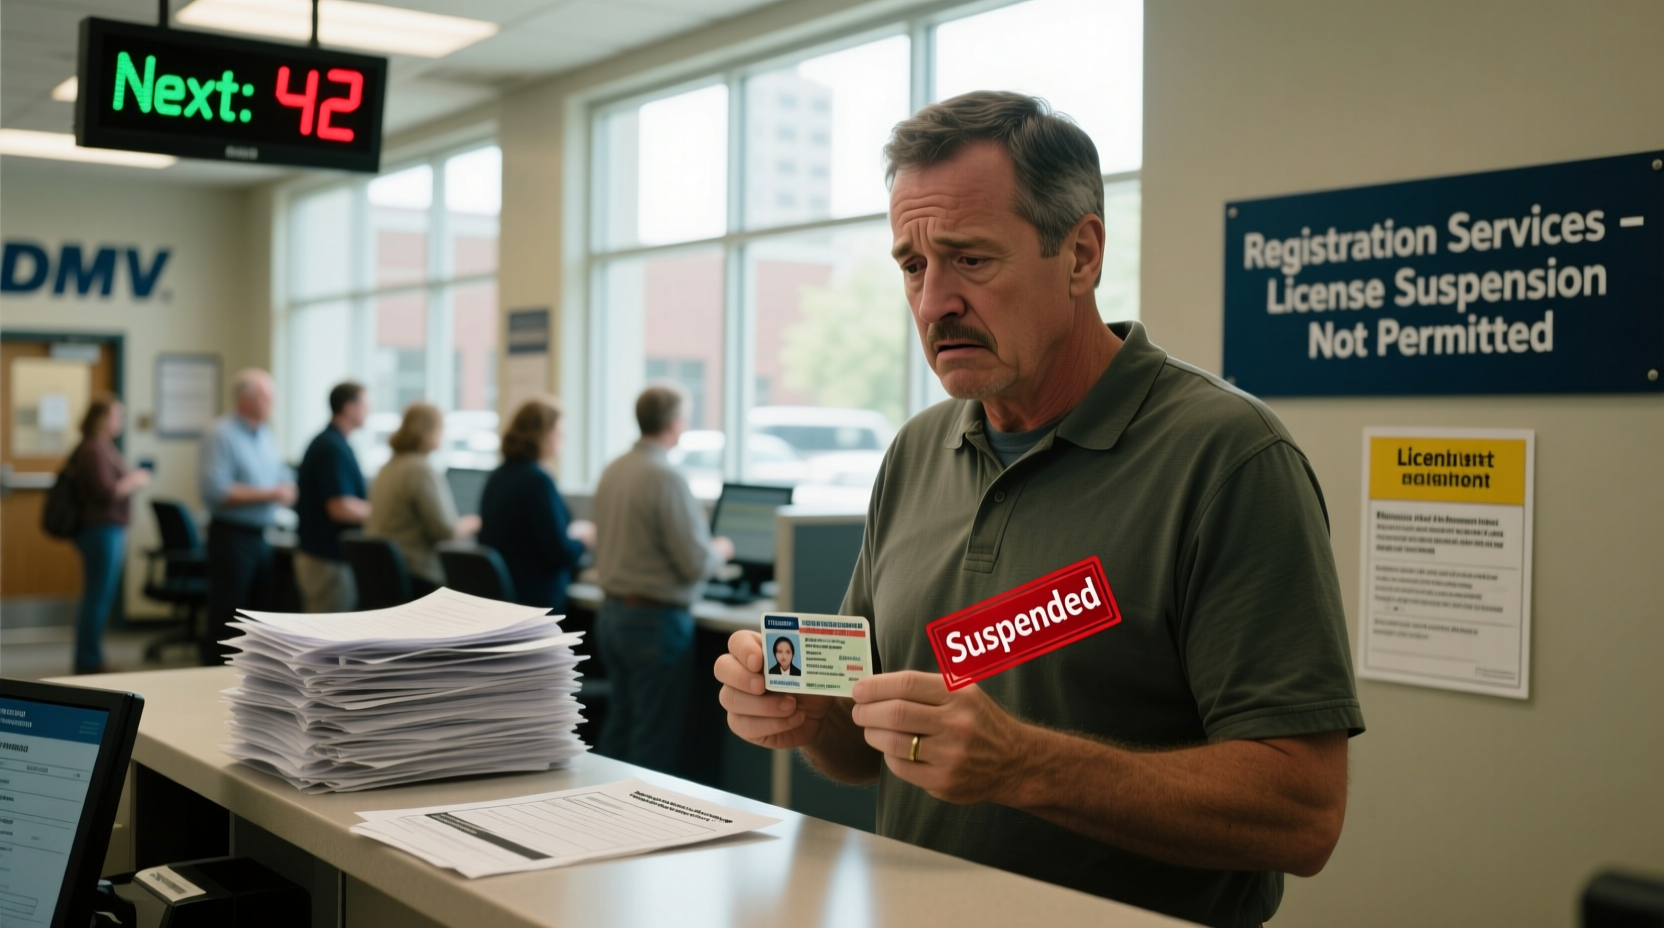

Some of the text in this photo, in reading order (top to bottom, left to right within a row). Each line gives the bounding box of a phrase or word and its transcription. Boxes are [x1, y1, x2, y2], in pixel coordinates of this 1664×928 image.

[112, 51, 364, 142] Next: 42
[1243, 218, 1437, 276] Registration
[1447, 203, 1606, 253] Services
[0, 242, 171, 299] DMV
[1266, 257, 1607, 314] License Suspension
[1308, 310, 1554, 359] Not Permitted
